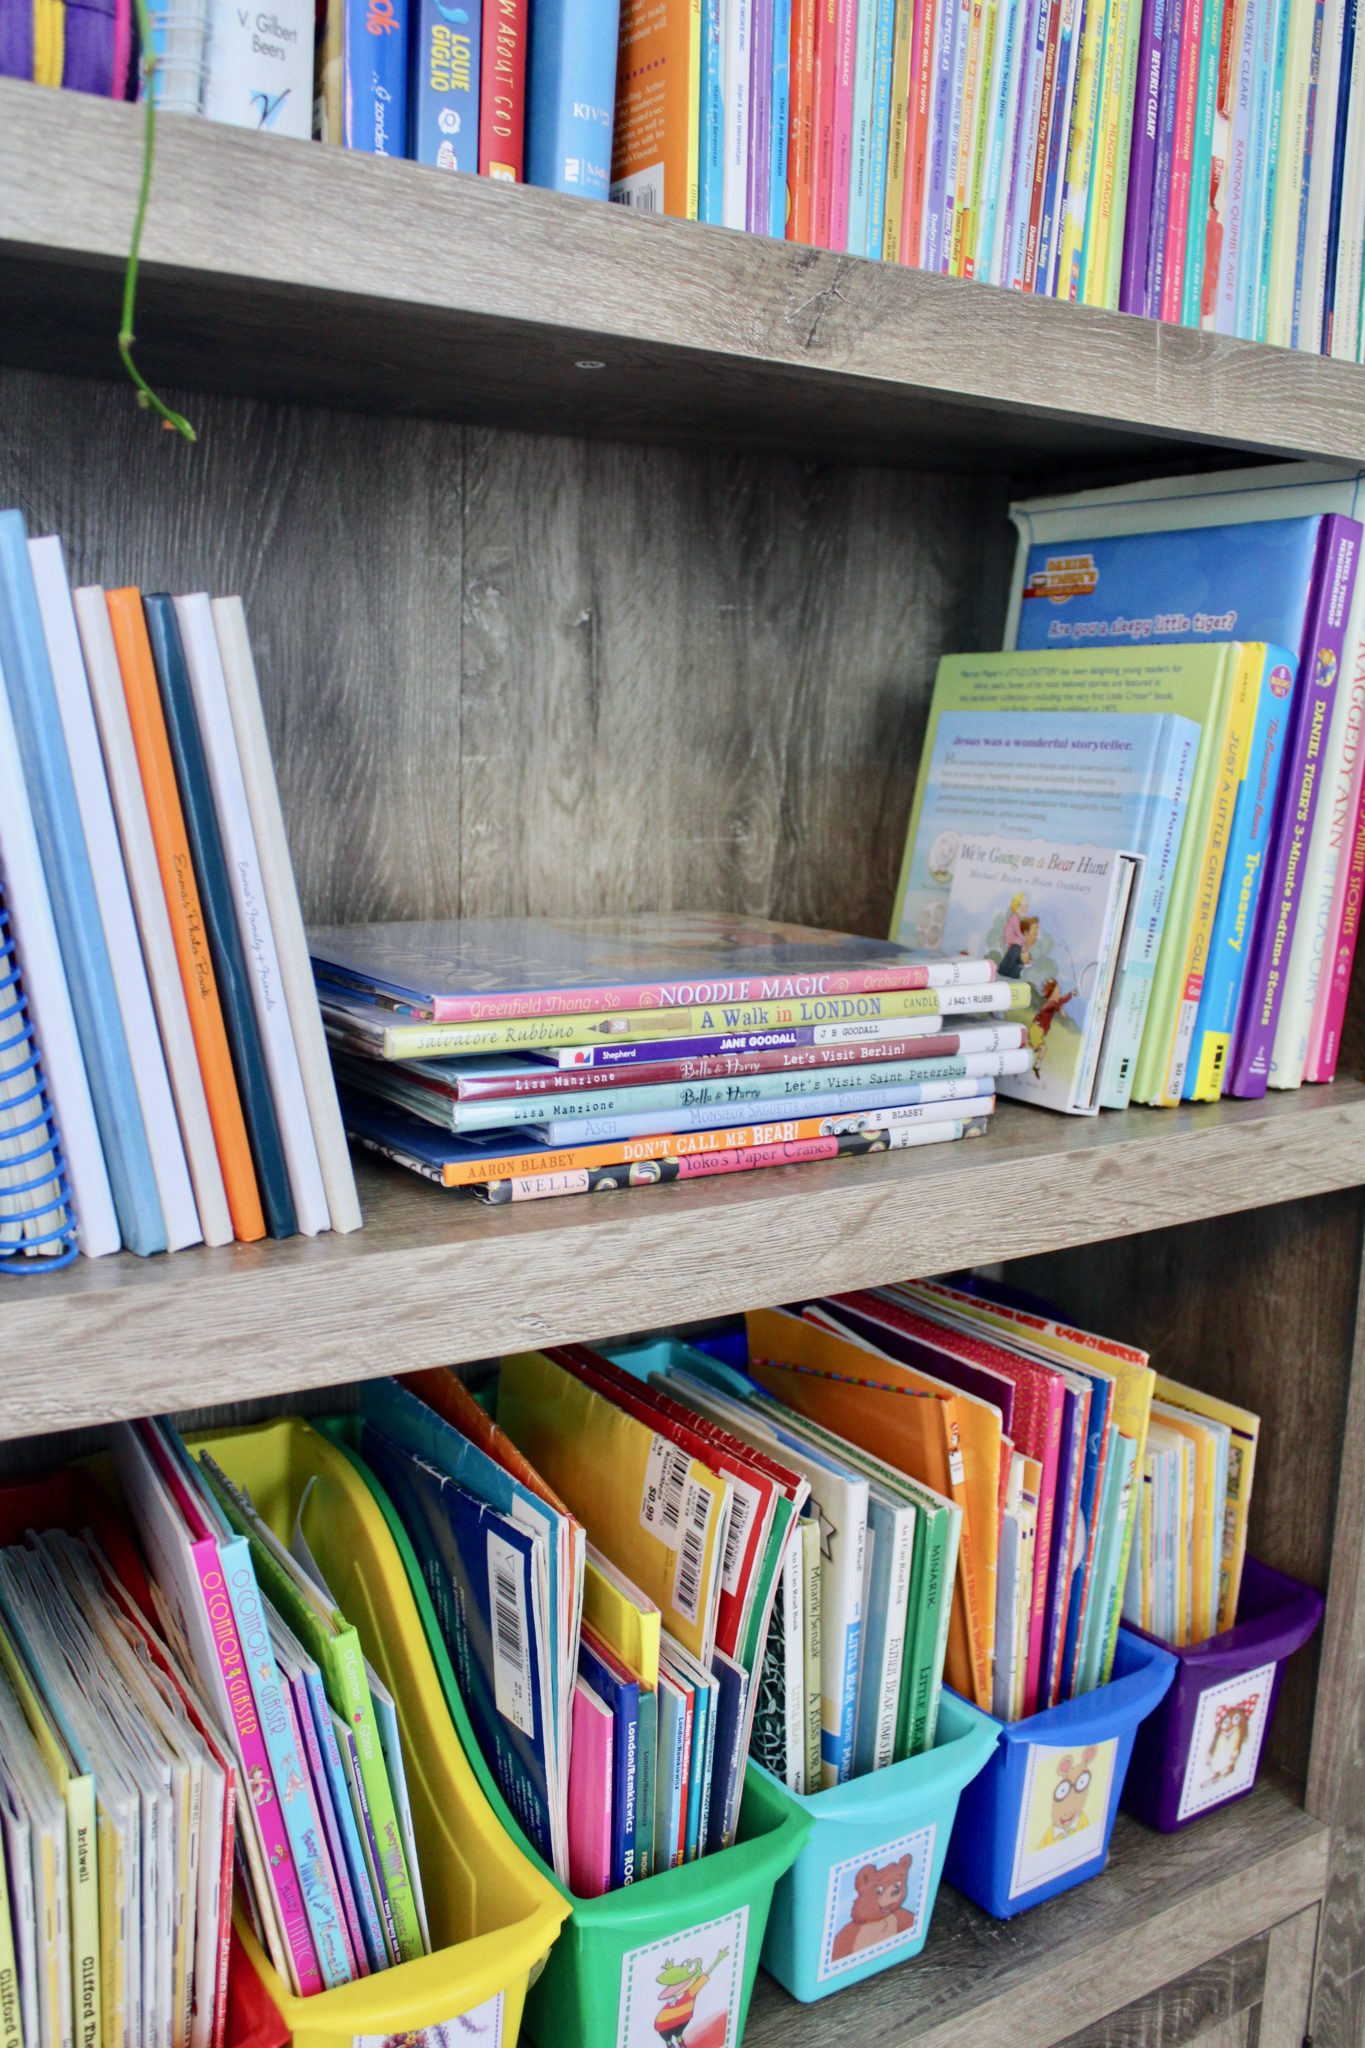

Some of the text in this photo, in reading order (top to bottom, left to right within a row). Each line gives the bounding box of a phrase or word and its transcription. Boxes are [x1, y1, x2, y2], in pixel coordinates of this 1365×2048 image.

[256, 13, 298, 44] Gilbert
[1191, 4, 1199, 36] CLEARY
[1210, 14, 1218, 48] CLEARY
[1243, 2, 1255, 55] BEVERLY
[252, 34, 286, 61] Beers
[430, 25, 450, 92] GIGLIO
[451, 33, 471, 92] LOUIE
[1188, 43, 1197, 80] RAMONA
[1207, 54, 1215, 84] HENRY
[493, 22, 517, 136] ABOUT GOD
[920, 85, 928, 114] TOWN
[1146, 50, 1161, 140] BEVERLY CLEARY
[1187, 82, 1195, 102] AND
[1239, 60, 1250, 110] CLEARY
[1203, 104, 1212, 136] BEEZUS
[1233, 140, 1245, 200] RAMONA
[1024, 225, 1037, 283] Dadey/Jones
[1226, 264, 1234, 288] AGE
[1306, 700, 1326, 758] DANIEL
[1212, 731, 1239, 849] JUST A LITTLE
[1297, 763, 1319, 821] TIGER'S
[989, 847, 1019, 870] Going
[1022, 855, 1034, 864] on
[1036, 856, 1044, 867] a
[1048, 853, 1075, 872] Bear
[1077, 856, 1109, 876] Hunt
[1283, 825, 1306, 896] 3-Minute
[1228, 851, 1261, 952] Treasury
[1271, 901, 1291, 966] Bedtime
[657, 975, 830, 1008] NOODLE MAGIC
[1260, 970, 1279, 1026] Stories
[417, 997, 882, 1050] Salvatore Rubbino A Walk in LONDON
[602, 1031, 797, 1061] Shepherd JANE GOODALL
[842, 1024, 881, 1037] GOODALL
[515, 1078, 546, 1091] Lisa
[554, 1071, 616, 1088] Manzione
[680, 1060, 713, 1079] Bella
[783, 1052, 816, 1067] Let's
[821, 1049, 855, 1064] Visit
[860, 1042, 906, 1060] Berlin!
[515, 1072, 903, 1119] Lisa Manzione Let's Visit Saint
[468, 1123, 800, 1179] AARON BLABEY DON'T CALL ME BEAR!
[519, 1141, 833, 1194] WELLS Yoko's Paper Cranes
[645, 1486, 657, 1522] $0.99
[202, 1571, 242, 1666] O'CONNOR
[229, 1679, 256, 1736] GLASSER
[916, 1544, 941, 1710] MINARIK LITTLE
[807, 1566, 821, 1770] Minarik/Sendak A KISS FOR
[886, 1637, 902, 1676] FATHER
[261, 1685, 286, 1735] GLASSER
[884, 1680, 898, 1711] BEAR
[879, 1714, 895, 1749] COMES
[624, 1720, 637, 1834] London/Remkiewicz
[77, 1828, 89, 1883] Bridwell
[0, 1969, 17, 2034] Clifford
[81, 1957, 95, 2019] Clifford
